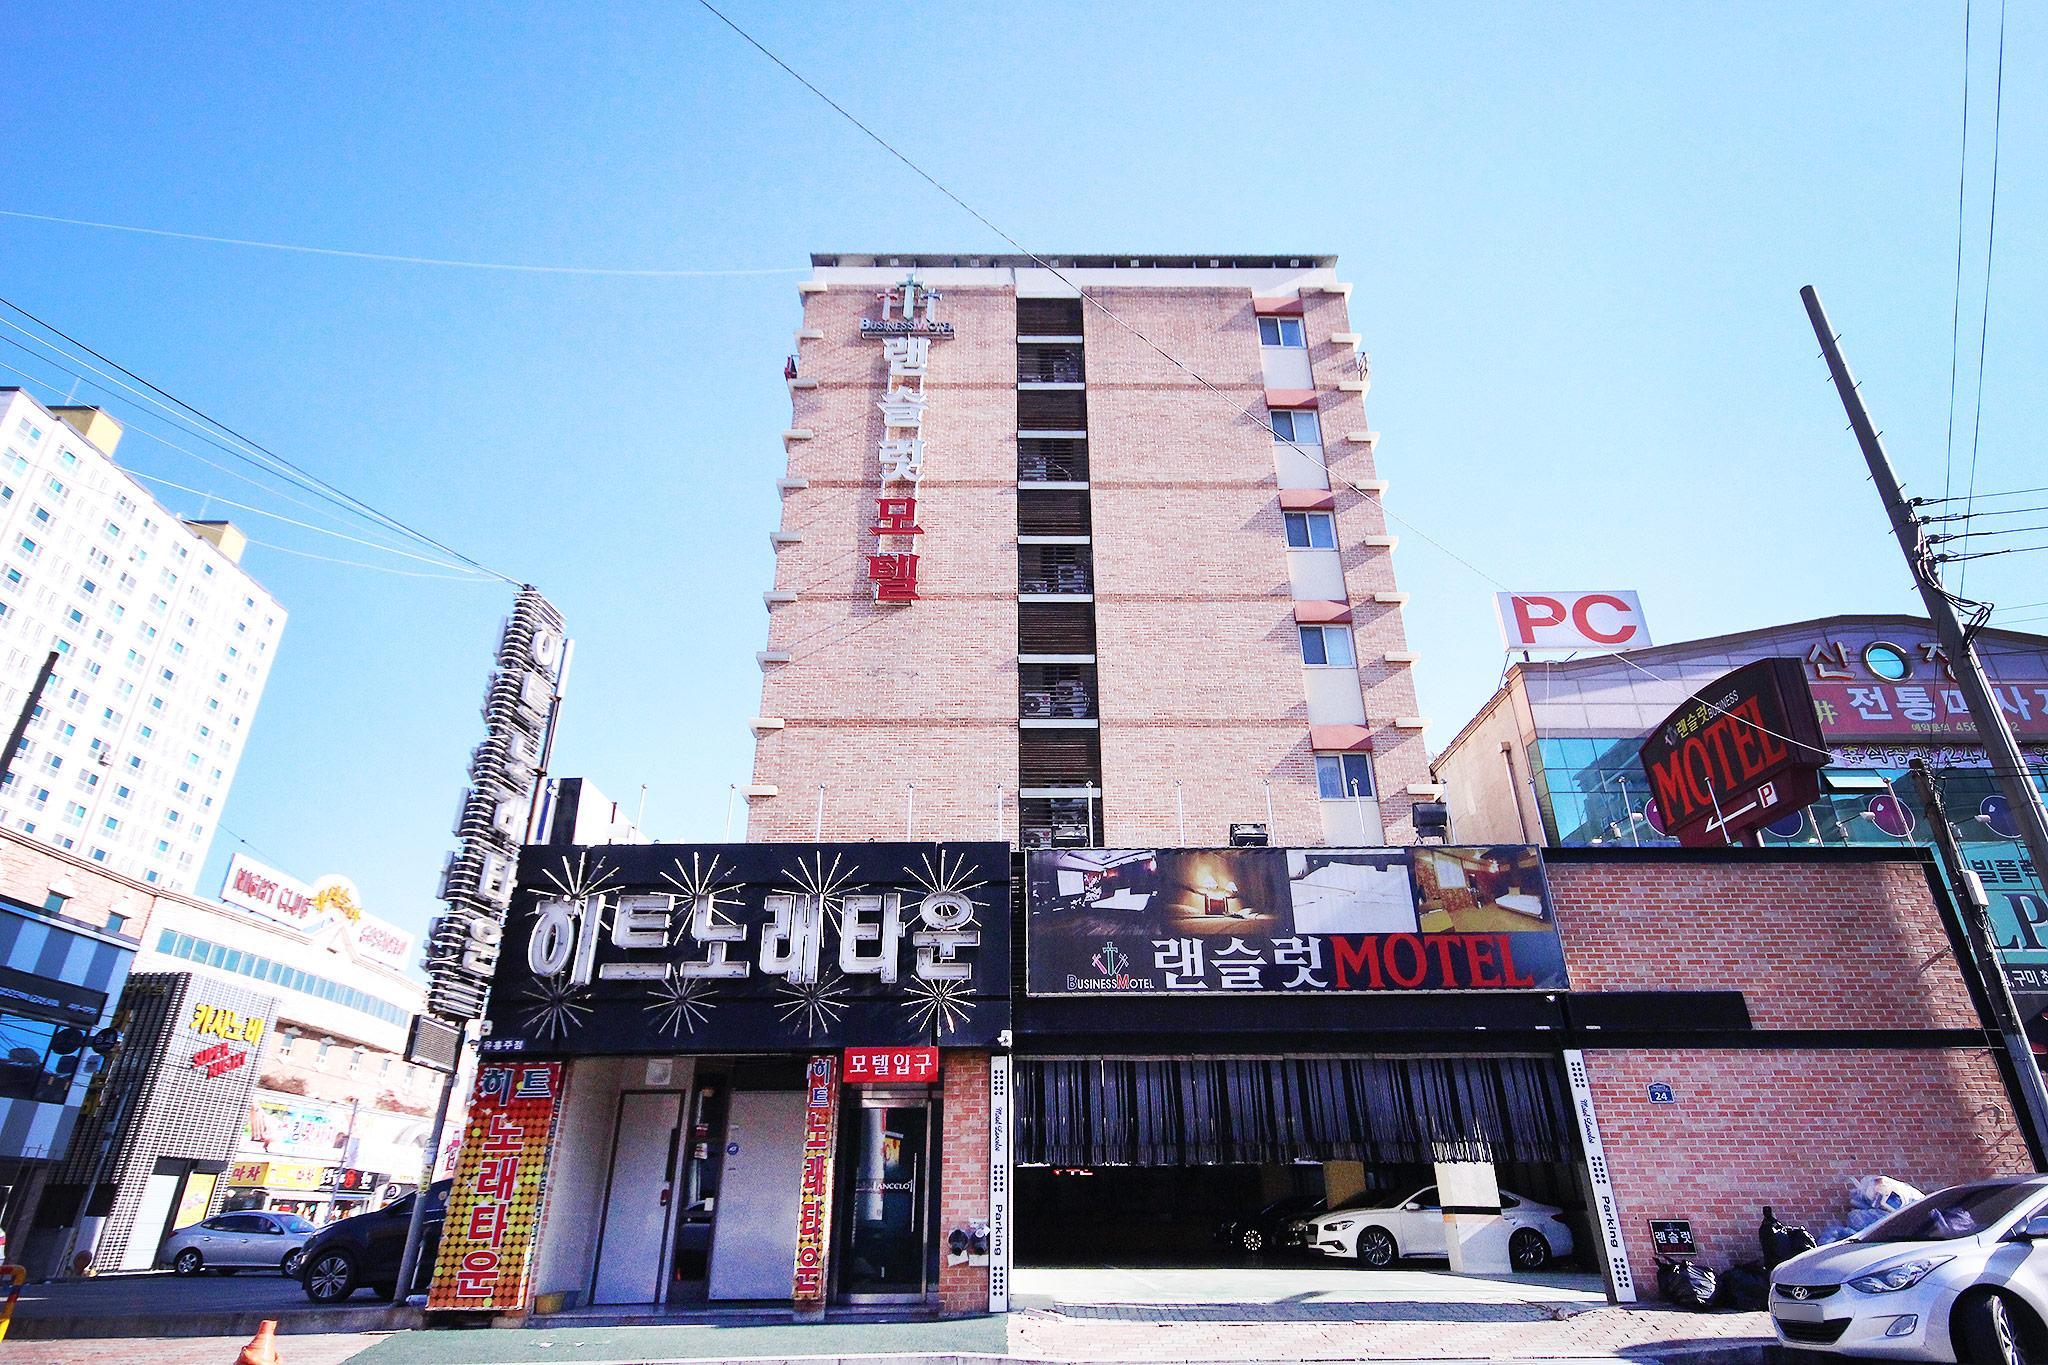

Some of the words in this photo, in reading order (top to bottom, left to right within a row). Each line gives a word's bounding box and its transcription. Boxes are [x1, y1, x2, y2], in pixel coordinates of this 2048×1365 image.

[876, 337, 931, 482] 랜슬럿
[866, 497, 924, 602] 모텔
[1510, 594, 1638, 645] PC
[1675, 704, 1710, 738] 랜슬럿
[1652, 694, 1788, 827] MOTEL
[1759, 784, 1774, 807] P
[233, 867, 279, 904] NIGHT
[527, 890, 981, 985] 히트노래타운
[1152, 936, 1327, 990] 랜슬럿
[1328, 932, 1534, 990] MOTEL
[191, 1042, 230, 1069] SUPER
[483, 1038, 525, 1050] 유흥주점
[207, 1049, 248, 1080] NIGHT
[849, 1053, 933, 1076] 모텔입구
[480, 1066, 552, 1106] 히트
[1654, 1091, 1668, 1101] 24
[994, 1204, 1004, 1256] Parking
[1602, 1195, 1619, 1248] Parking
